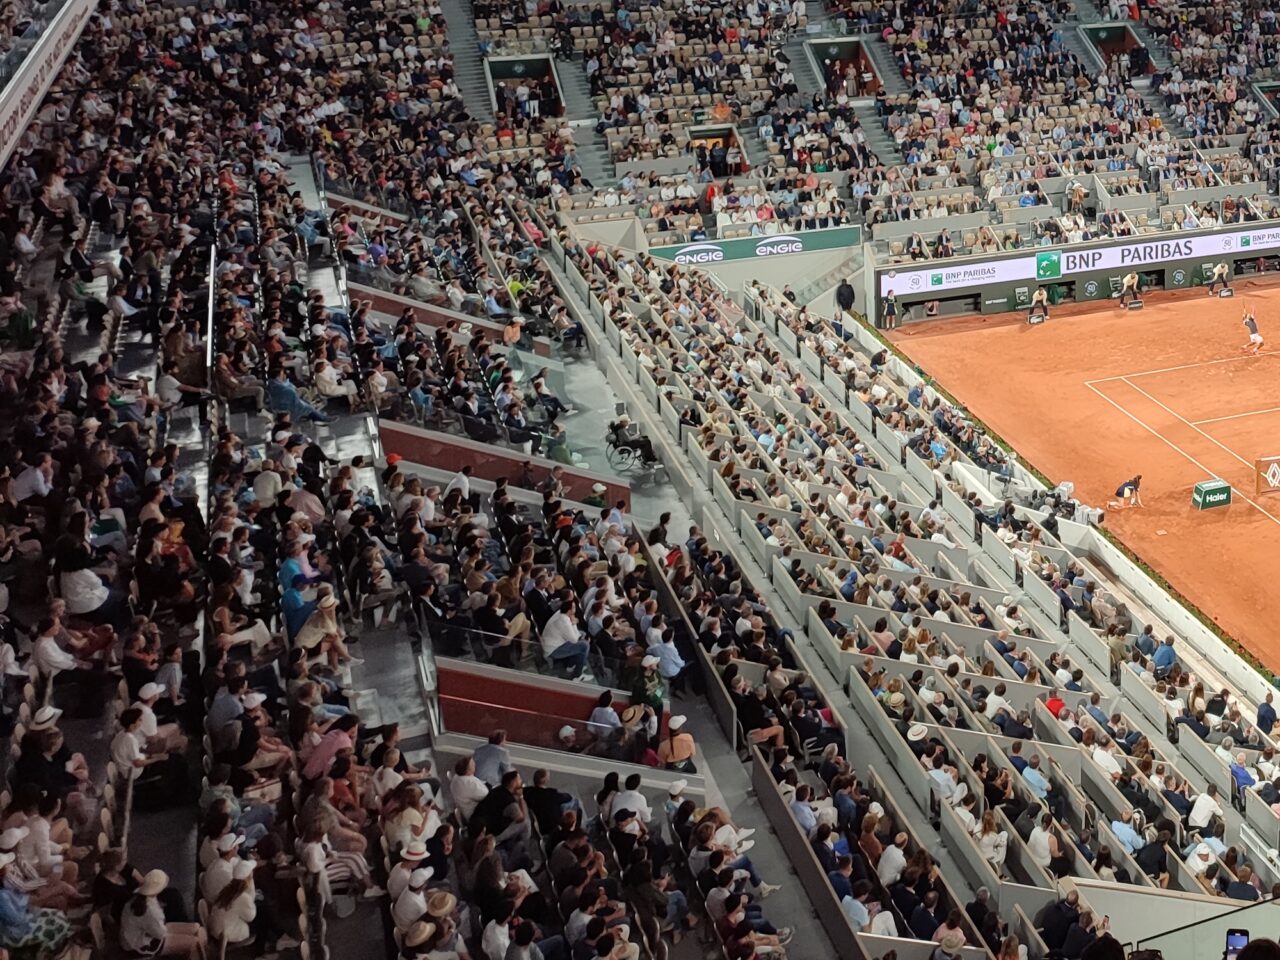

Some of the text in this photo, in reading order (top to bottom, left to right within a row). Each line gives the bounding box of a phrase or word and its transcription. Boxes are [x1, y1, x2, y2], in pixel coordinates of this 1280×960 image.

[1252, 233, 1266, 242] BNP
[1066, 240, 1193, 271] BNP PARIBAS
[945, 266, 996, 280] BNP PARIBAS
[1205, 492, 1228, 503] Haier
